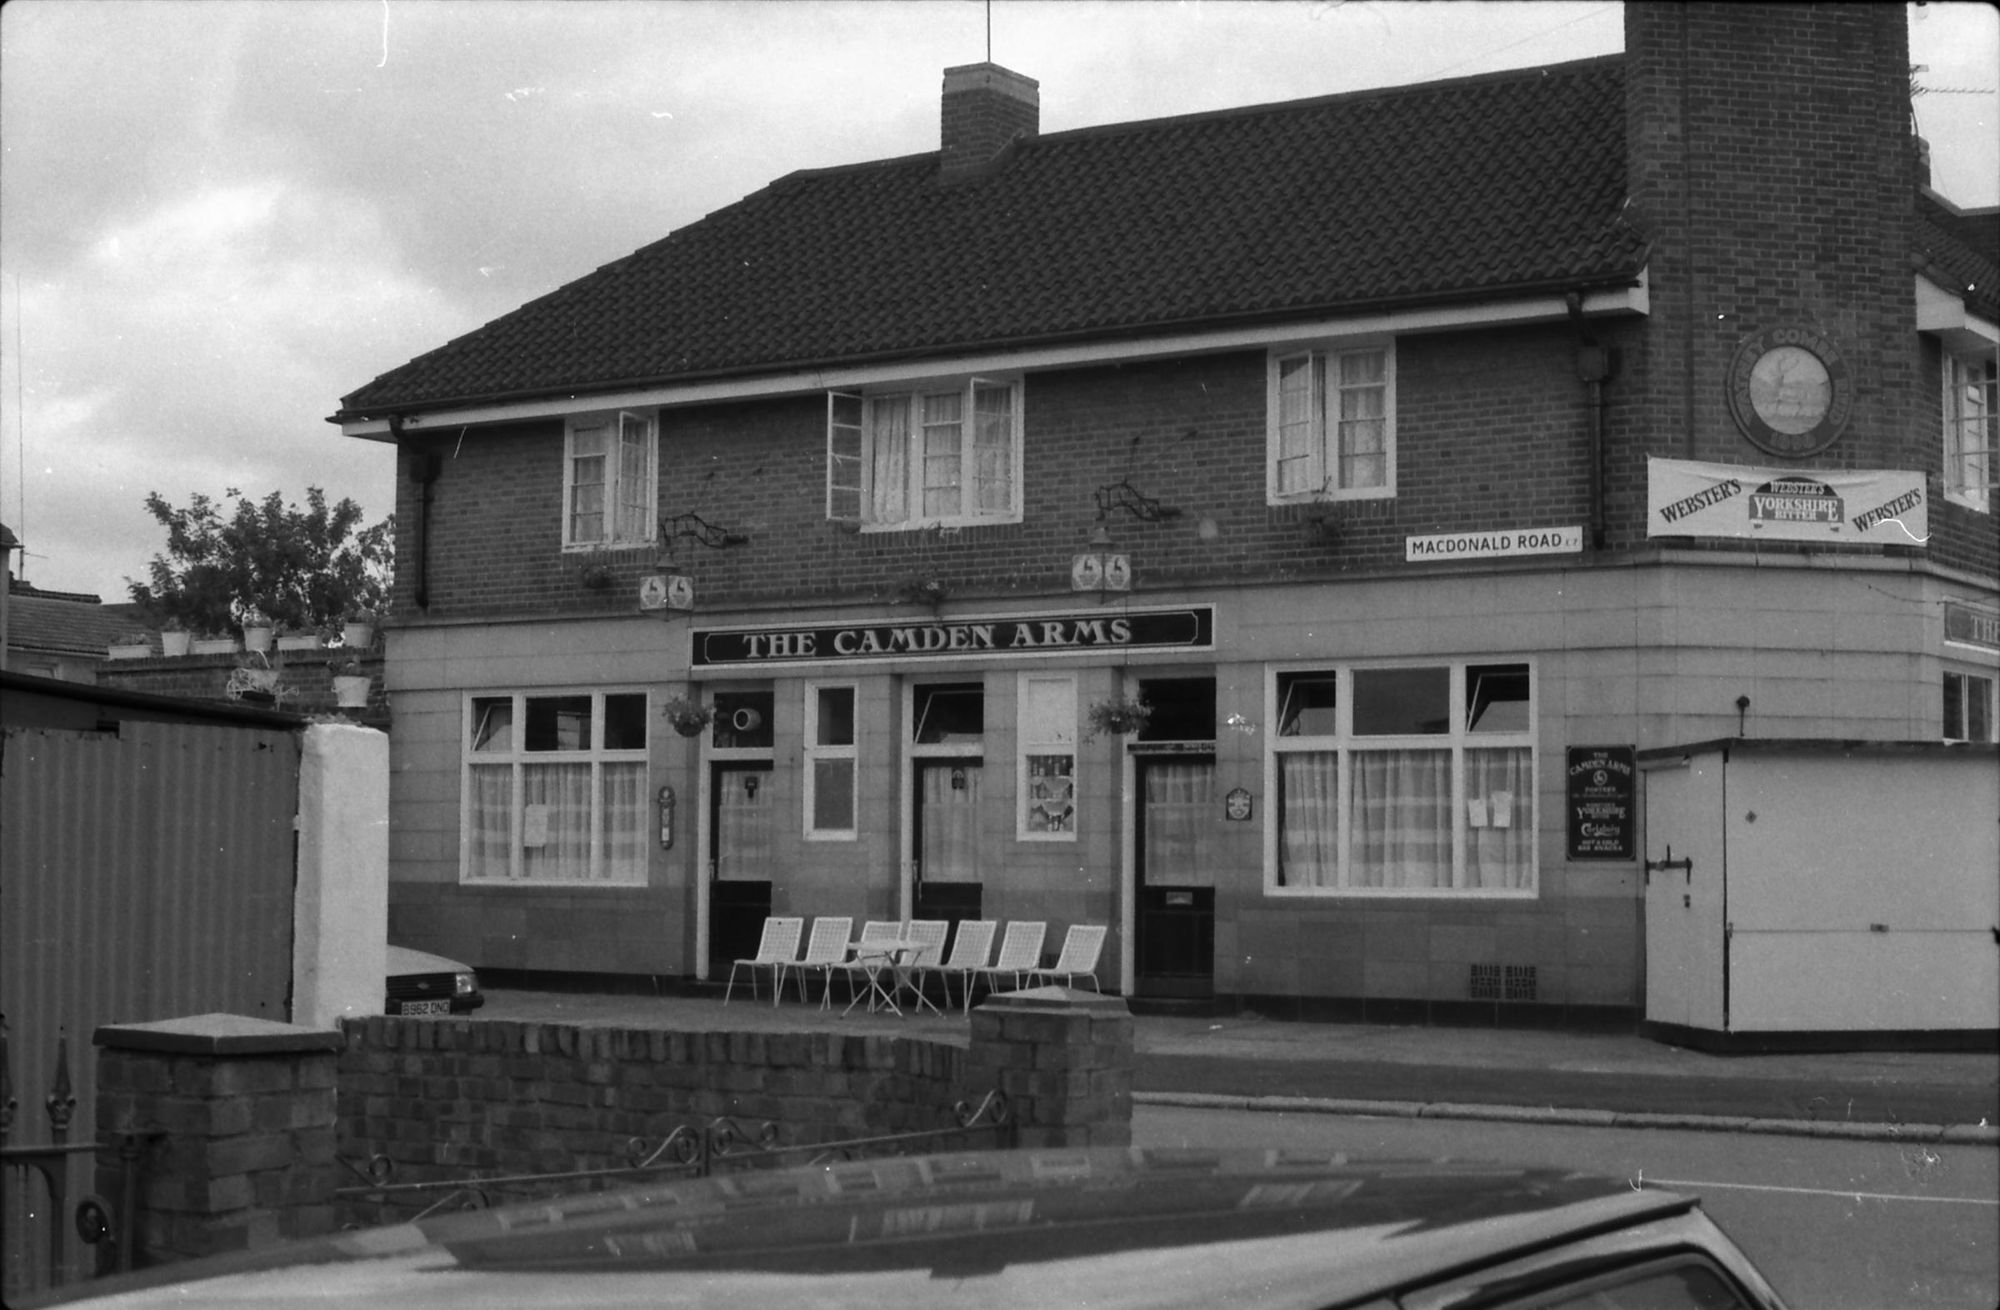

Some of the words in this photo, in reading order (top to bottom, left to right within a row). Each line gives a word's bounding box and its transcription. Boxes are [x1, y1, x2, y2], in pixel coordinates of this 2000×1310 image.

[1659, 478, 1742, 523] WEBSTER'S
[1770, 481, 1824, 495] WEBSTER'S
[1754, 496, 1839, 521] YORKSHIRE
[1852, 487, 1922, 533] WEBSTER'S
[1412, 536, 1511, 554] MACDONALD
[1517, 533, 1562, 548] ROAD
[743, 631, 817, 659] THE
[833, 624, 997, 656] CAMDEN
[1010, 618, 1133, 648] ARMS
